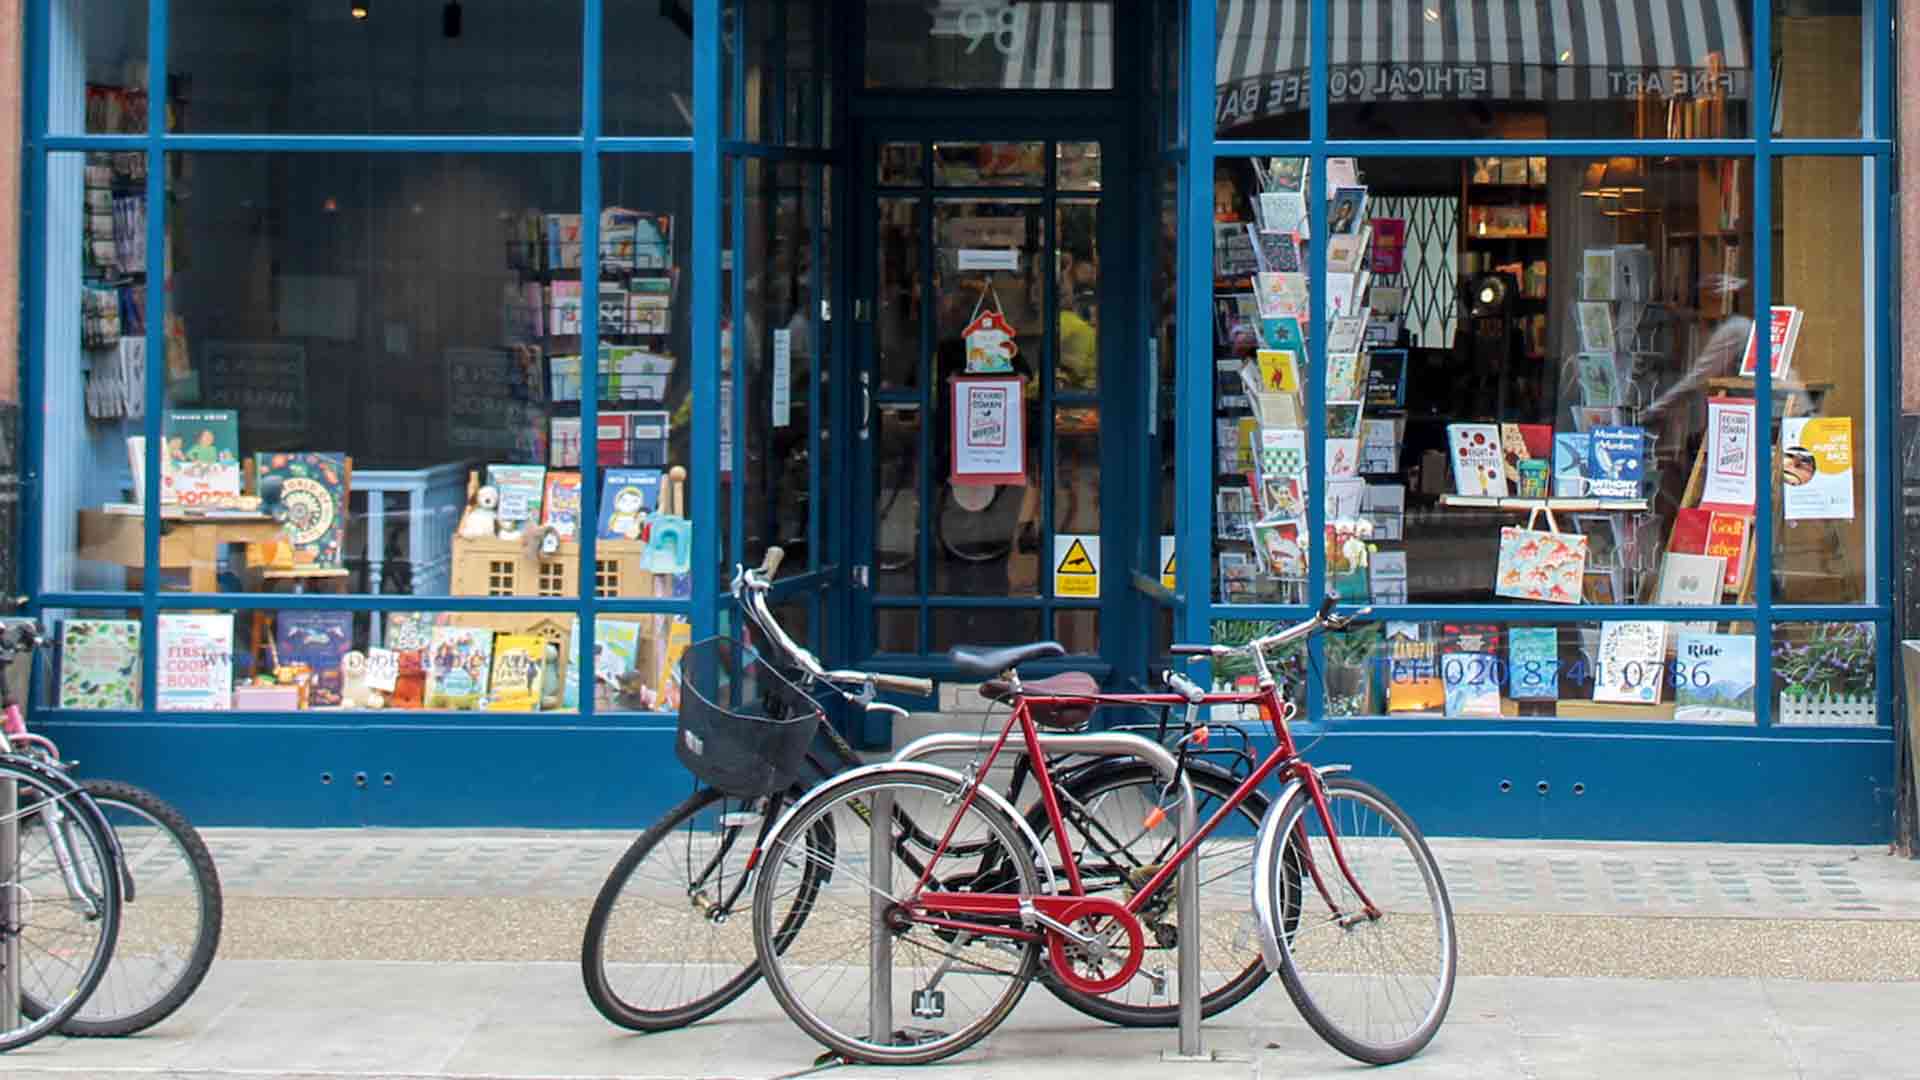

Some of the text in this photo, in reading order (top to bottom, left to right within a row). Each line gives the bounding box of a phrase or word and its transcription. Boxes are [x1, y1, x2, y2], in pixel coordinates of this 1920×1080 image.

[1688, 642, 1723, 658] Ride
[168, 673, 208, 688] BOOK
[1445, 658, 1508, 685] 020
[1523, 658, 1604, 686] 8741
[1623, 660, 1712, 688] 0786
